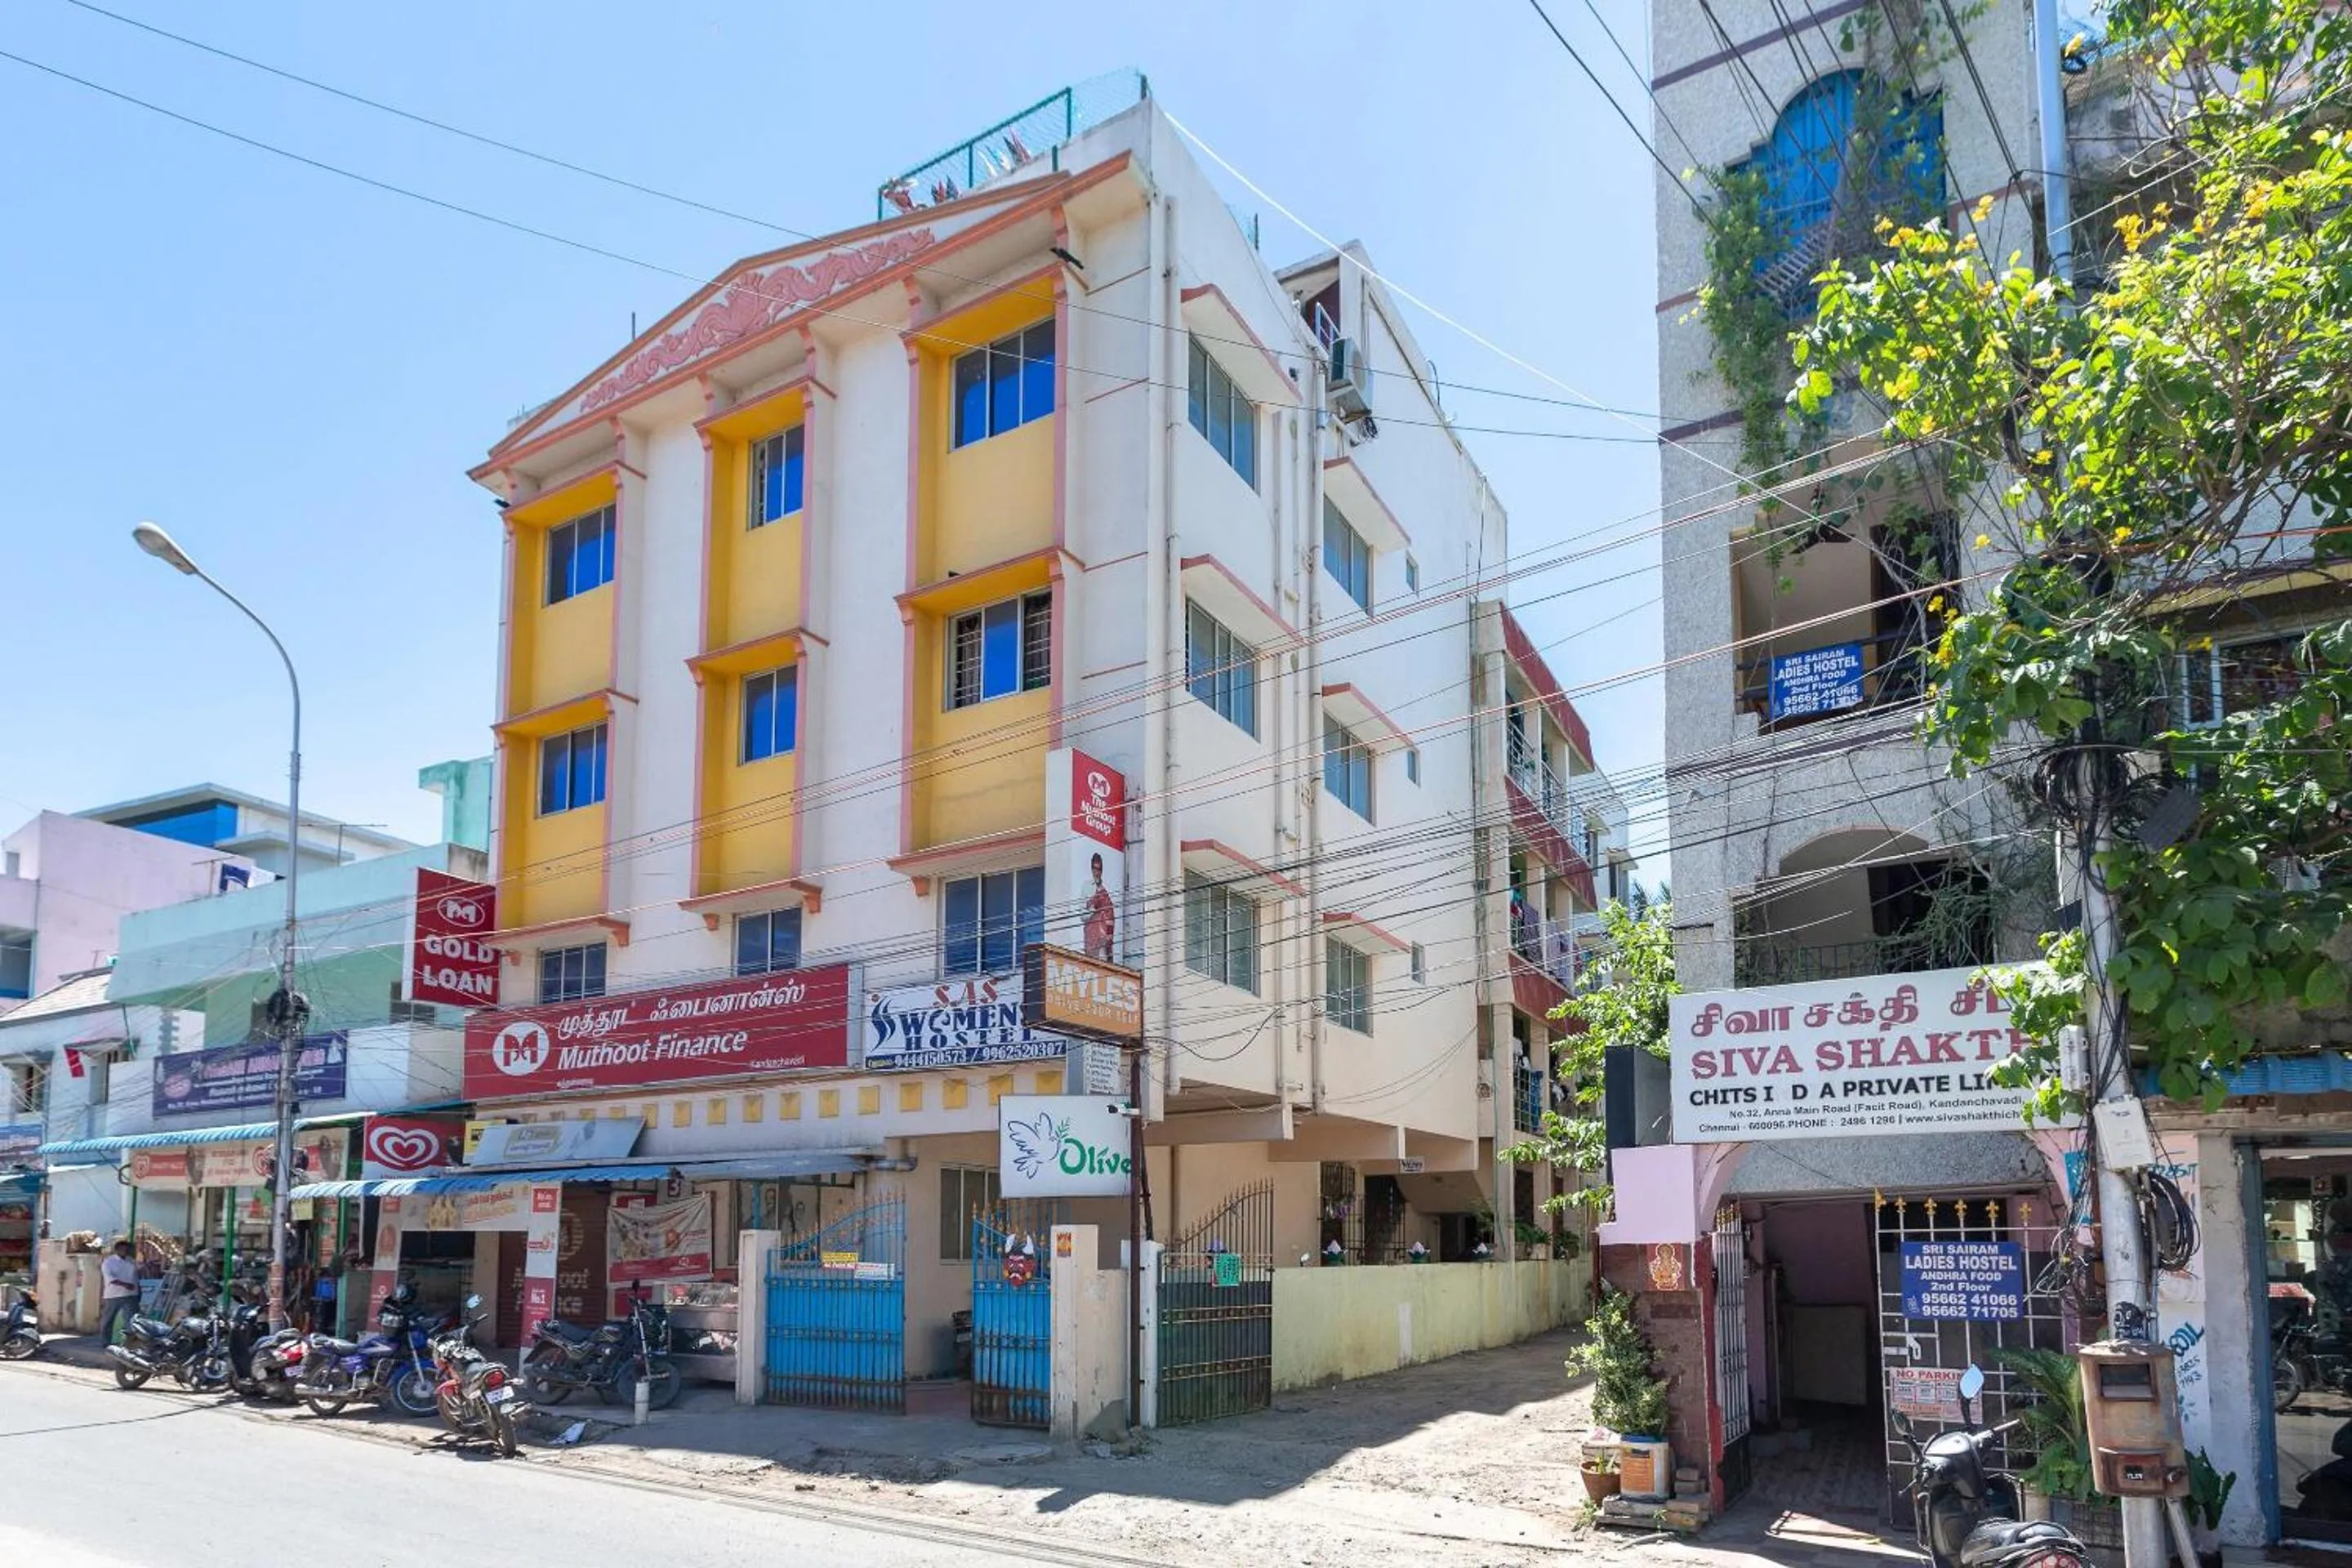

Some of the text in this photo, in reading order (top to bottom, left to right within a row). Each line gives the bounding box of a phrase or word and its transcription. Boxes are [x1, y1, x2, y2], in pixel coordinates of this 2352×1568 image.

[1774, 655, 1859, 680] ADIES HOSTEL
[1785, 648, 1845, 667] SRI SAIRAM
[1822, 670, 1846, 681] FOOD
[1791, 680, 1838, 694] 2nd Floor
[425, 933, 494, 963] GOLD
[423, 965, 493, 995] LOAN
[1046, 960, 1138, 1012] MYLES
[933, 979, 1000, 1008] SAS
[899, 1002, 1024, 1036] WOMEN
[1691, 1003, 1794, 1037] சிவா
[1803, 984, 1918, 1032] சக்தி
[905, 1027, 1036, 1051] HOSTEL
[558, 1031, 748, 1070] Muthoot Finance
[1691, 1027, 2037, 1080] SIVA SHAKTH
[1690, 1087, 1757, 1106] CHITS
[1843, 1076, 1950, 1098] PRIVATE
[1763, 1107, 1791, 1116] Anna
[1794, 1106, 1819, 1115] Main
[1823, 1104, 1851, 1114] Road
[1699, 1123, 1740, 1133] Chennai
[1060, 1138, 1133, 1174] Olive
[1922, 1245, 1998, 1255] SRI SAIRAM
[1905, 1255, 2016, 1270] LADIES HOSTEL
[1921, 1272, 2002, 1281] ANDHRA FOOD
[1931, 1282, 1992, 1291] 2nd Floor
[1922, 1294, 2017, 1306] 95662 41066
[1922, 1306, 2017, 1318] 95662 71705
[1896, 1370, 1960, 1380] NO PARKI
